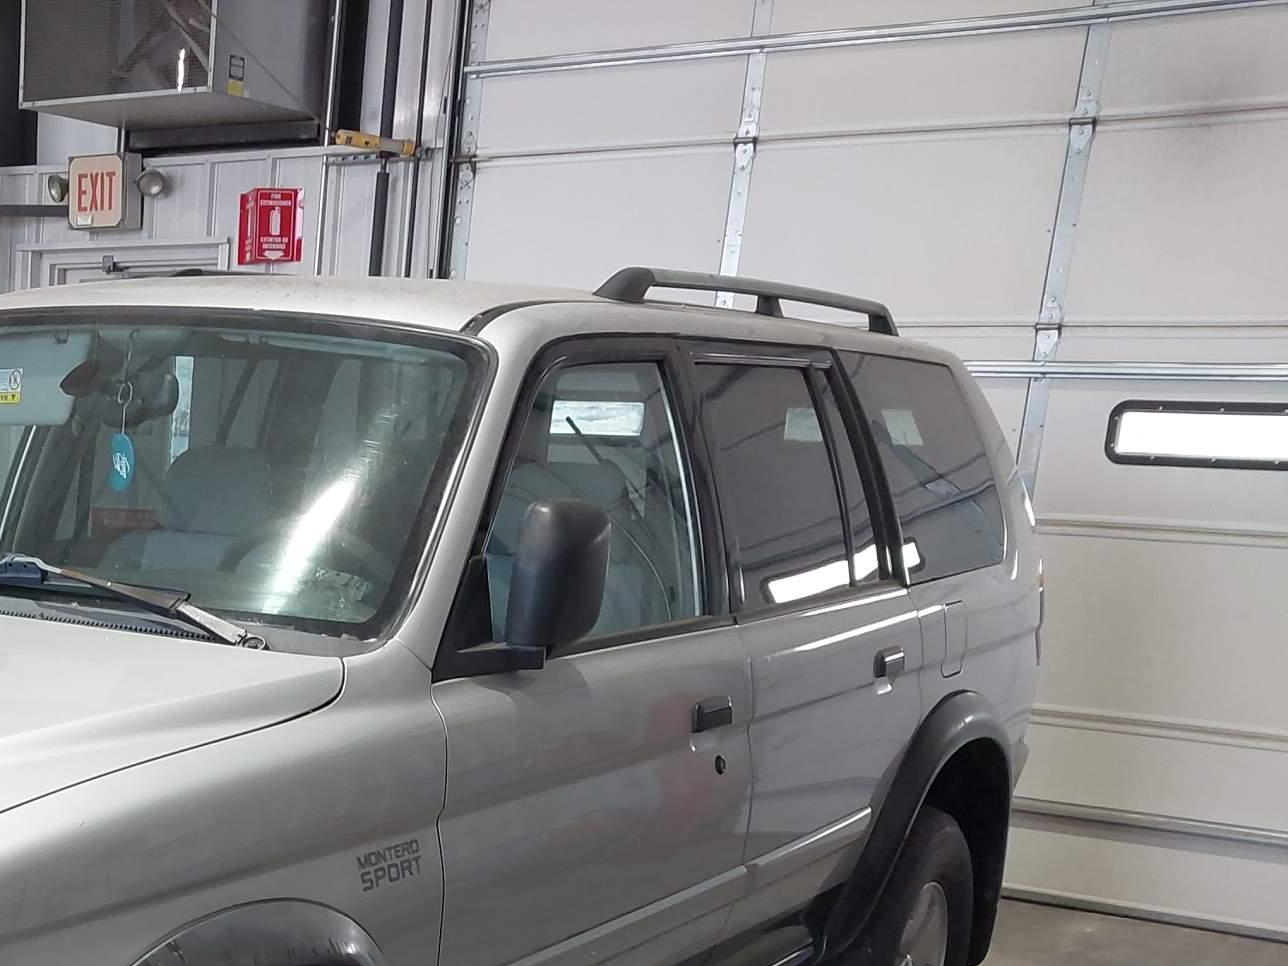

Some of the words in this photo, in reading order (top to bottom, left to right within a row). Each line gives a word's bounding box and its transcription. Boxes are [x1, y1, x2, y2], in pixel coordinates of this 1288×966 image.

[77, 171, 116, 212] EXIT
[356, 839, 420, 869] MONTERO
[361, 855, 421, 892] SPORT
